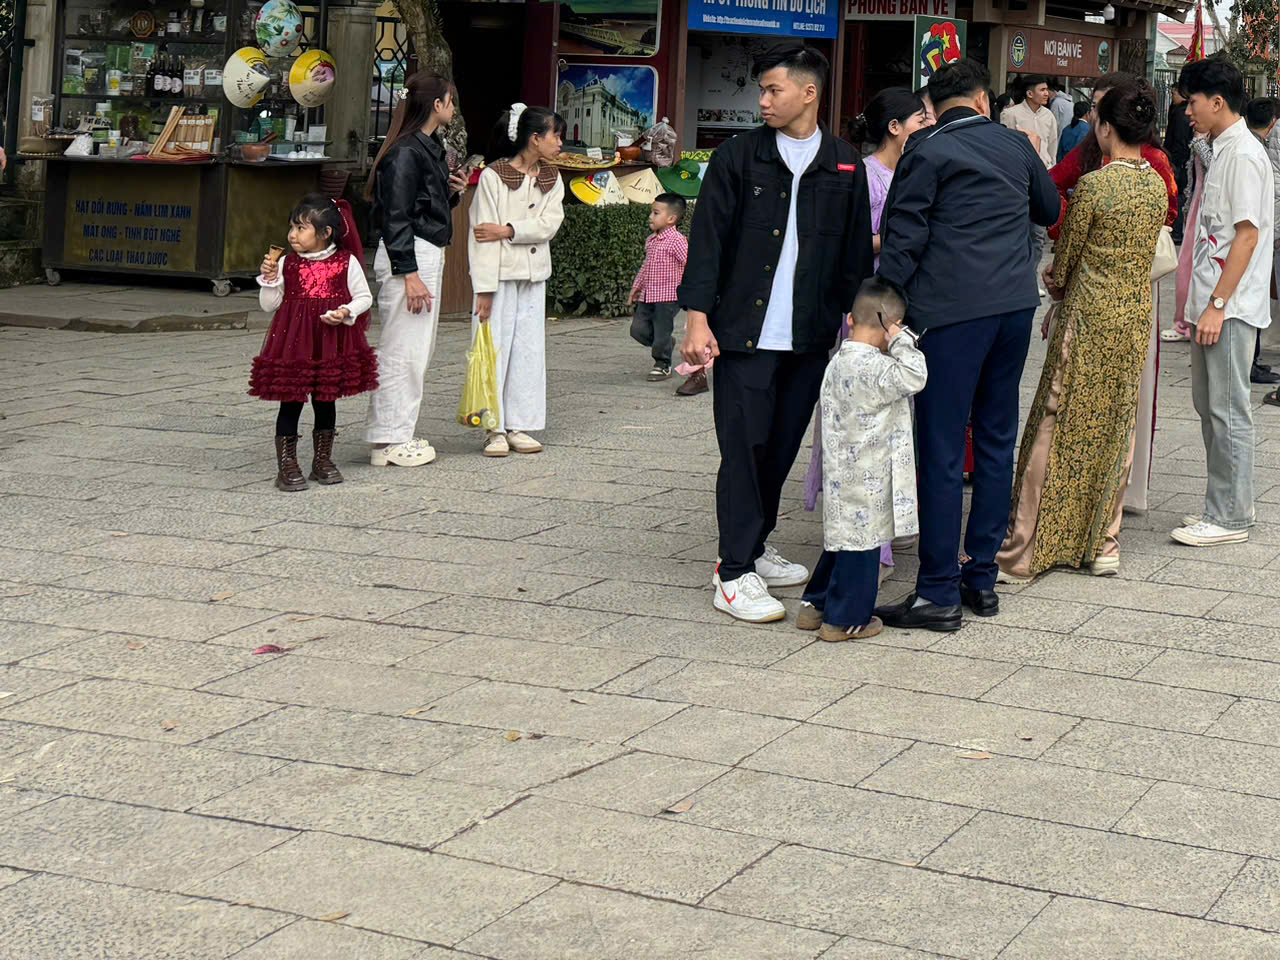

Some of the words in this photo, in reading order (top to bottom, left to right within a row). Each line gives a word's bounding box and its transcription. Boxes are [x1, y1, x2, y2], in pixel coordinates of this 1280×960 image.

[1044, 39, 1057, 55] NƠI
[1057, 38, 1072, 57] BÁN
[1072, 40, 1082, 58] VÉ
[154, 204, 169, 217] LIM
[170, 205, 191, 219] XANH
[101, 225, 118, 240] ONG
[125, 226, 143, 240] TINH
